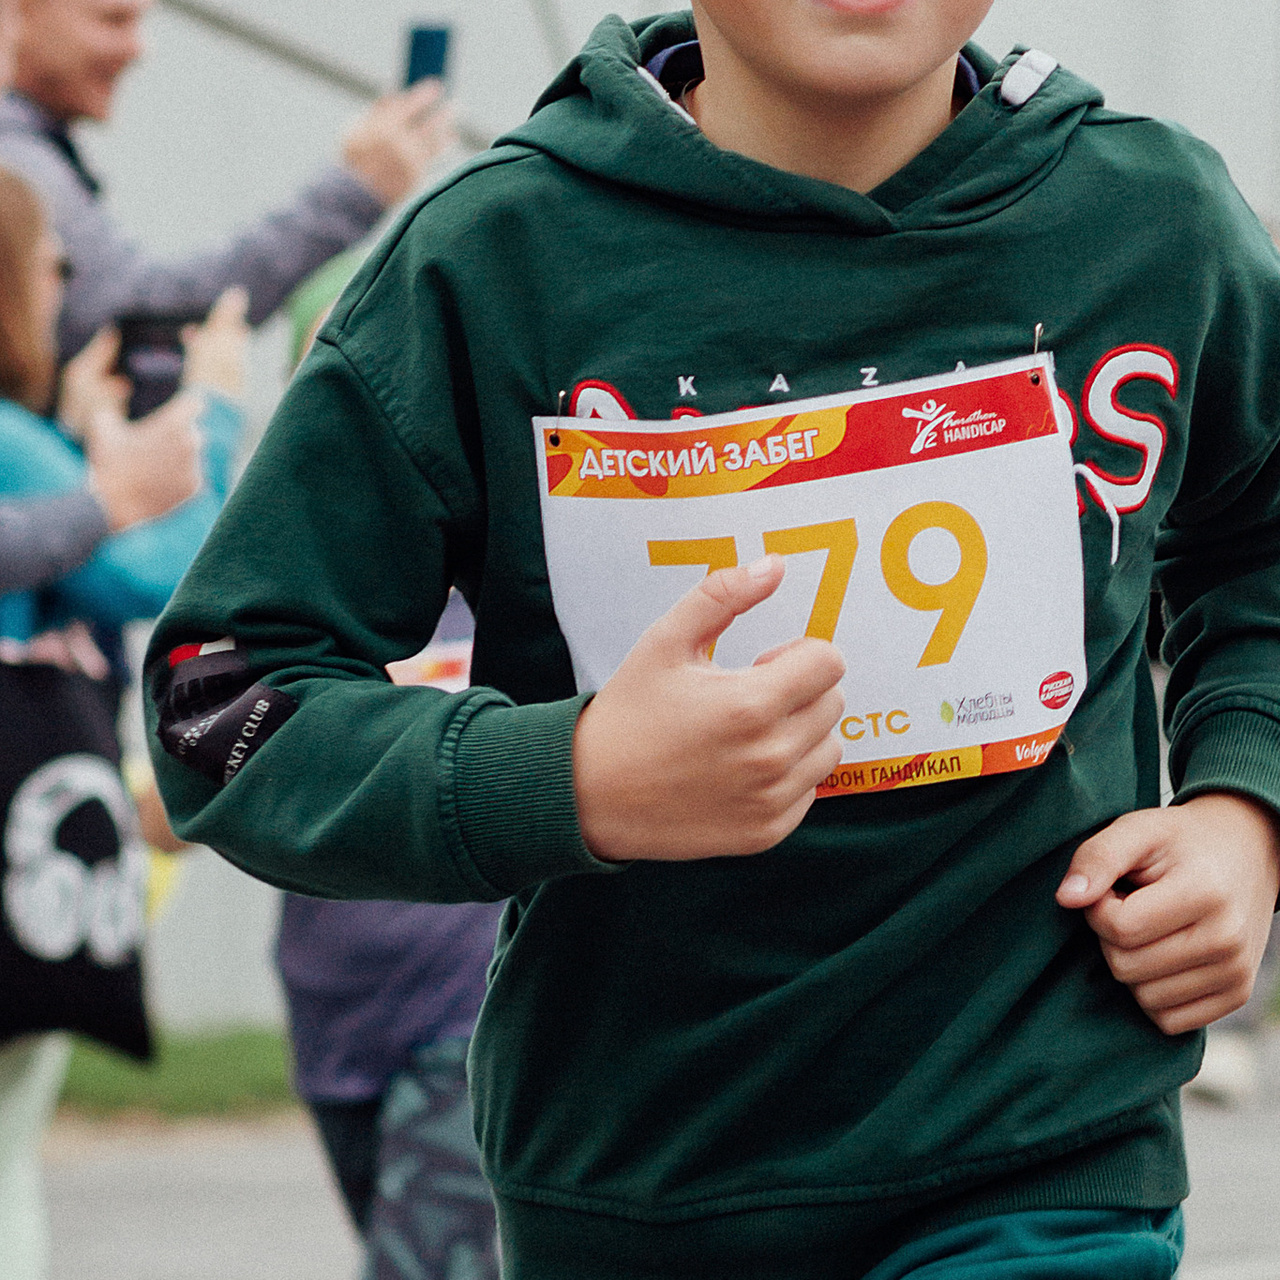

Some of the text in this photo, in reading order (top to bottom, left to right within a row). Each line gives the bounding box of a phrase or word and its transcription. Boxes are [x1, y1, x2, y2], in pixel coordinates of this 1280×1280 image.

[943, 418, 1007, 444] HANDICAP
[579, 429, 819, 481] ДЕТСКИЙ ЗАБЕГ
[646, 500, 989, 669] 779
[241, 699, 272, 738] CLUB
[871, 755, 962, 784] ГАНДИКАП
